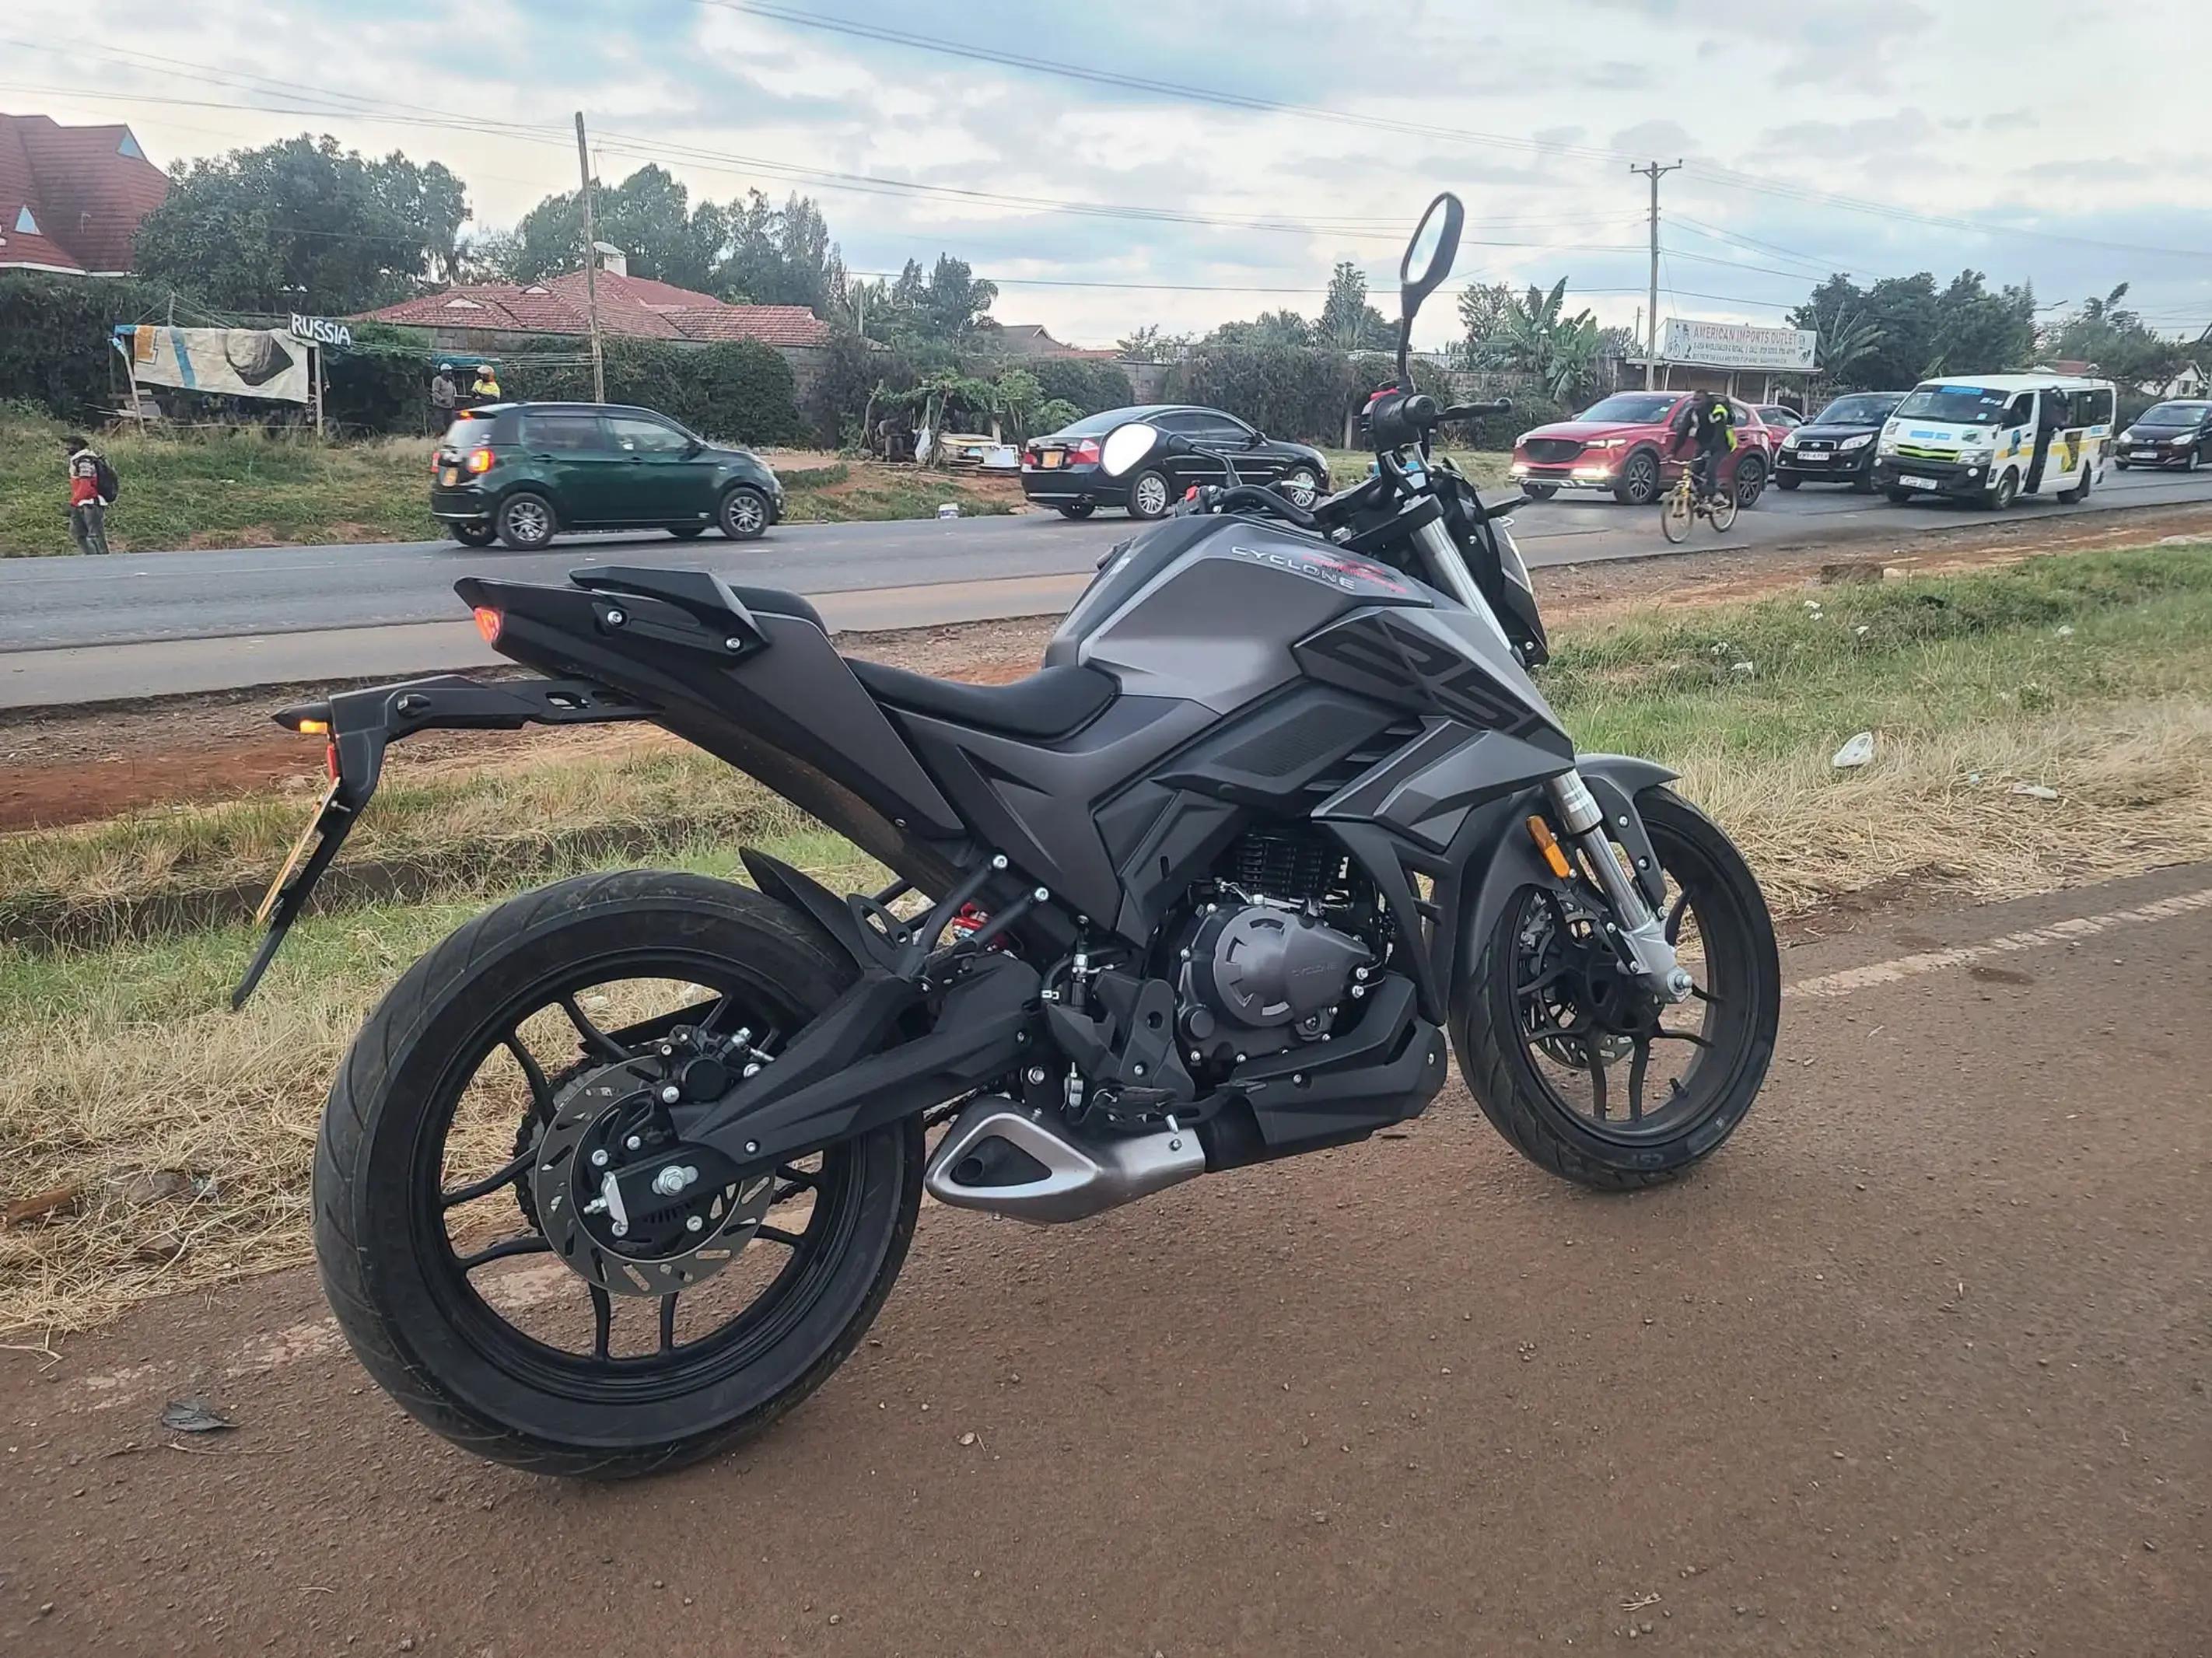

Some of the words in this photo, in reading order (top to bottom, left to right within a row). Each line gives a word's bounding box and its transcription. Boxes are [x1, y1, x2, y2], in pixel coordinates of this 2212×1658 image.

[291, 312, 352, 346] RUSSIA
[1692, 325, 1734, 342] AMERICAN
[1735, 328, 1769, 345] IMPORTS
[1770, 331, 1797, 347] OUTLET
[1231, 546, 1355, 590] CYCLONE
